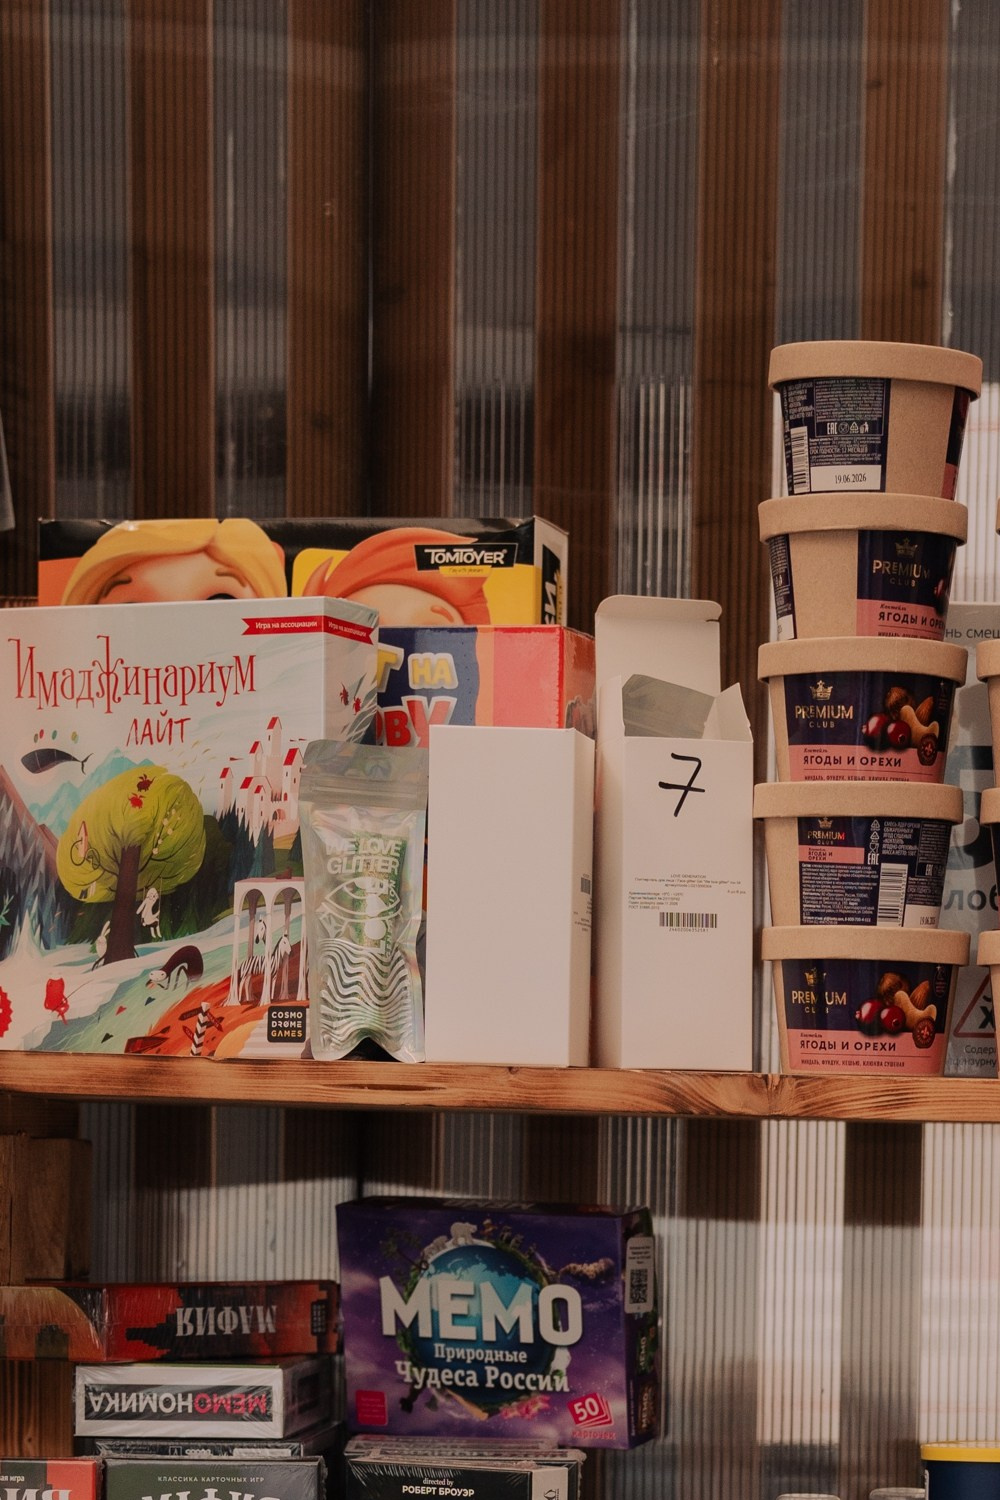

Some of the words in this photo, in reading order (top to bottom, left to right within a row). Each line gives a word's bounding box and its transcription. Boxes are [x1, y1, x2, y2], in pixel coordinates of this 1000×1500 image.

[835, 473, 866, 484] 19.06.2026
[424, 548, 505, 565] TOMTOYER
[255, 620, 270, 631] Игра
[271, 622, 279, 630] на
[280, 620, 318, 630] ассоциации
[878, 611, 918, 625] ЯГОДЫ
[921, 616, 928, 626] И
[8, 635, 257, 714] Имаджинариум
[411, 657, 451, 686] НА
[795, 705, 854, 719] PREMIUM
[126, 709, 191, 746] ЛАЙТ
[803, 755, 842, 766] ЯГОДЫ
[847, 756, 855, 765] И
[860, 756, 902, 768] ОРЕХИ
[658, 752, 705, 817] 7
[807, 830, 846, 841] PREMIUM
[326, 837, 357, 856] WE
[358, 837, 402, 856] LOVE
[326, 855, 400, 876] GLITTER
[271, 1011, 303, 1019] COSMO
[800, 1040, 837, 1050] ЯГОДЫ
[841, 1041, 849, 1050] И
[854, 1041, 896, 1052] ОРЕХИ
[379, 1275, 583, 1346] МЕМО
[175, 1305, 278, 1337] МАФИЯ
[434, 1343, 528, 1363] Природные
[395, 1360, 479, 1389] Чудеса
[485, 1365, 570, 1393] России
[88, 1391, 267, 1414] МЕМОНОМИКА
[573, 1398, 600, 1422] 50
[571, 1429, 617, 1441] карточек
[158, 1475, 199, 1483] КЛАССИКА
[249, 1476, 265, 1484] ИГР
[423, 1477, 446, 1486] directed
[446, 1478, 454, 1487] by
[402, 1485, 438, 1496] РОБЕРТ
[438, 1487, 475, 1497] БРОУЭР
